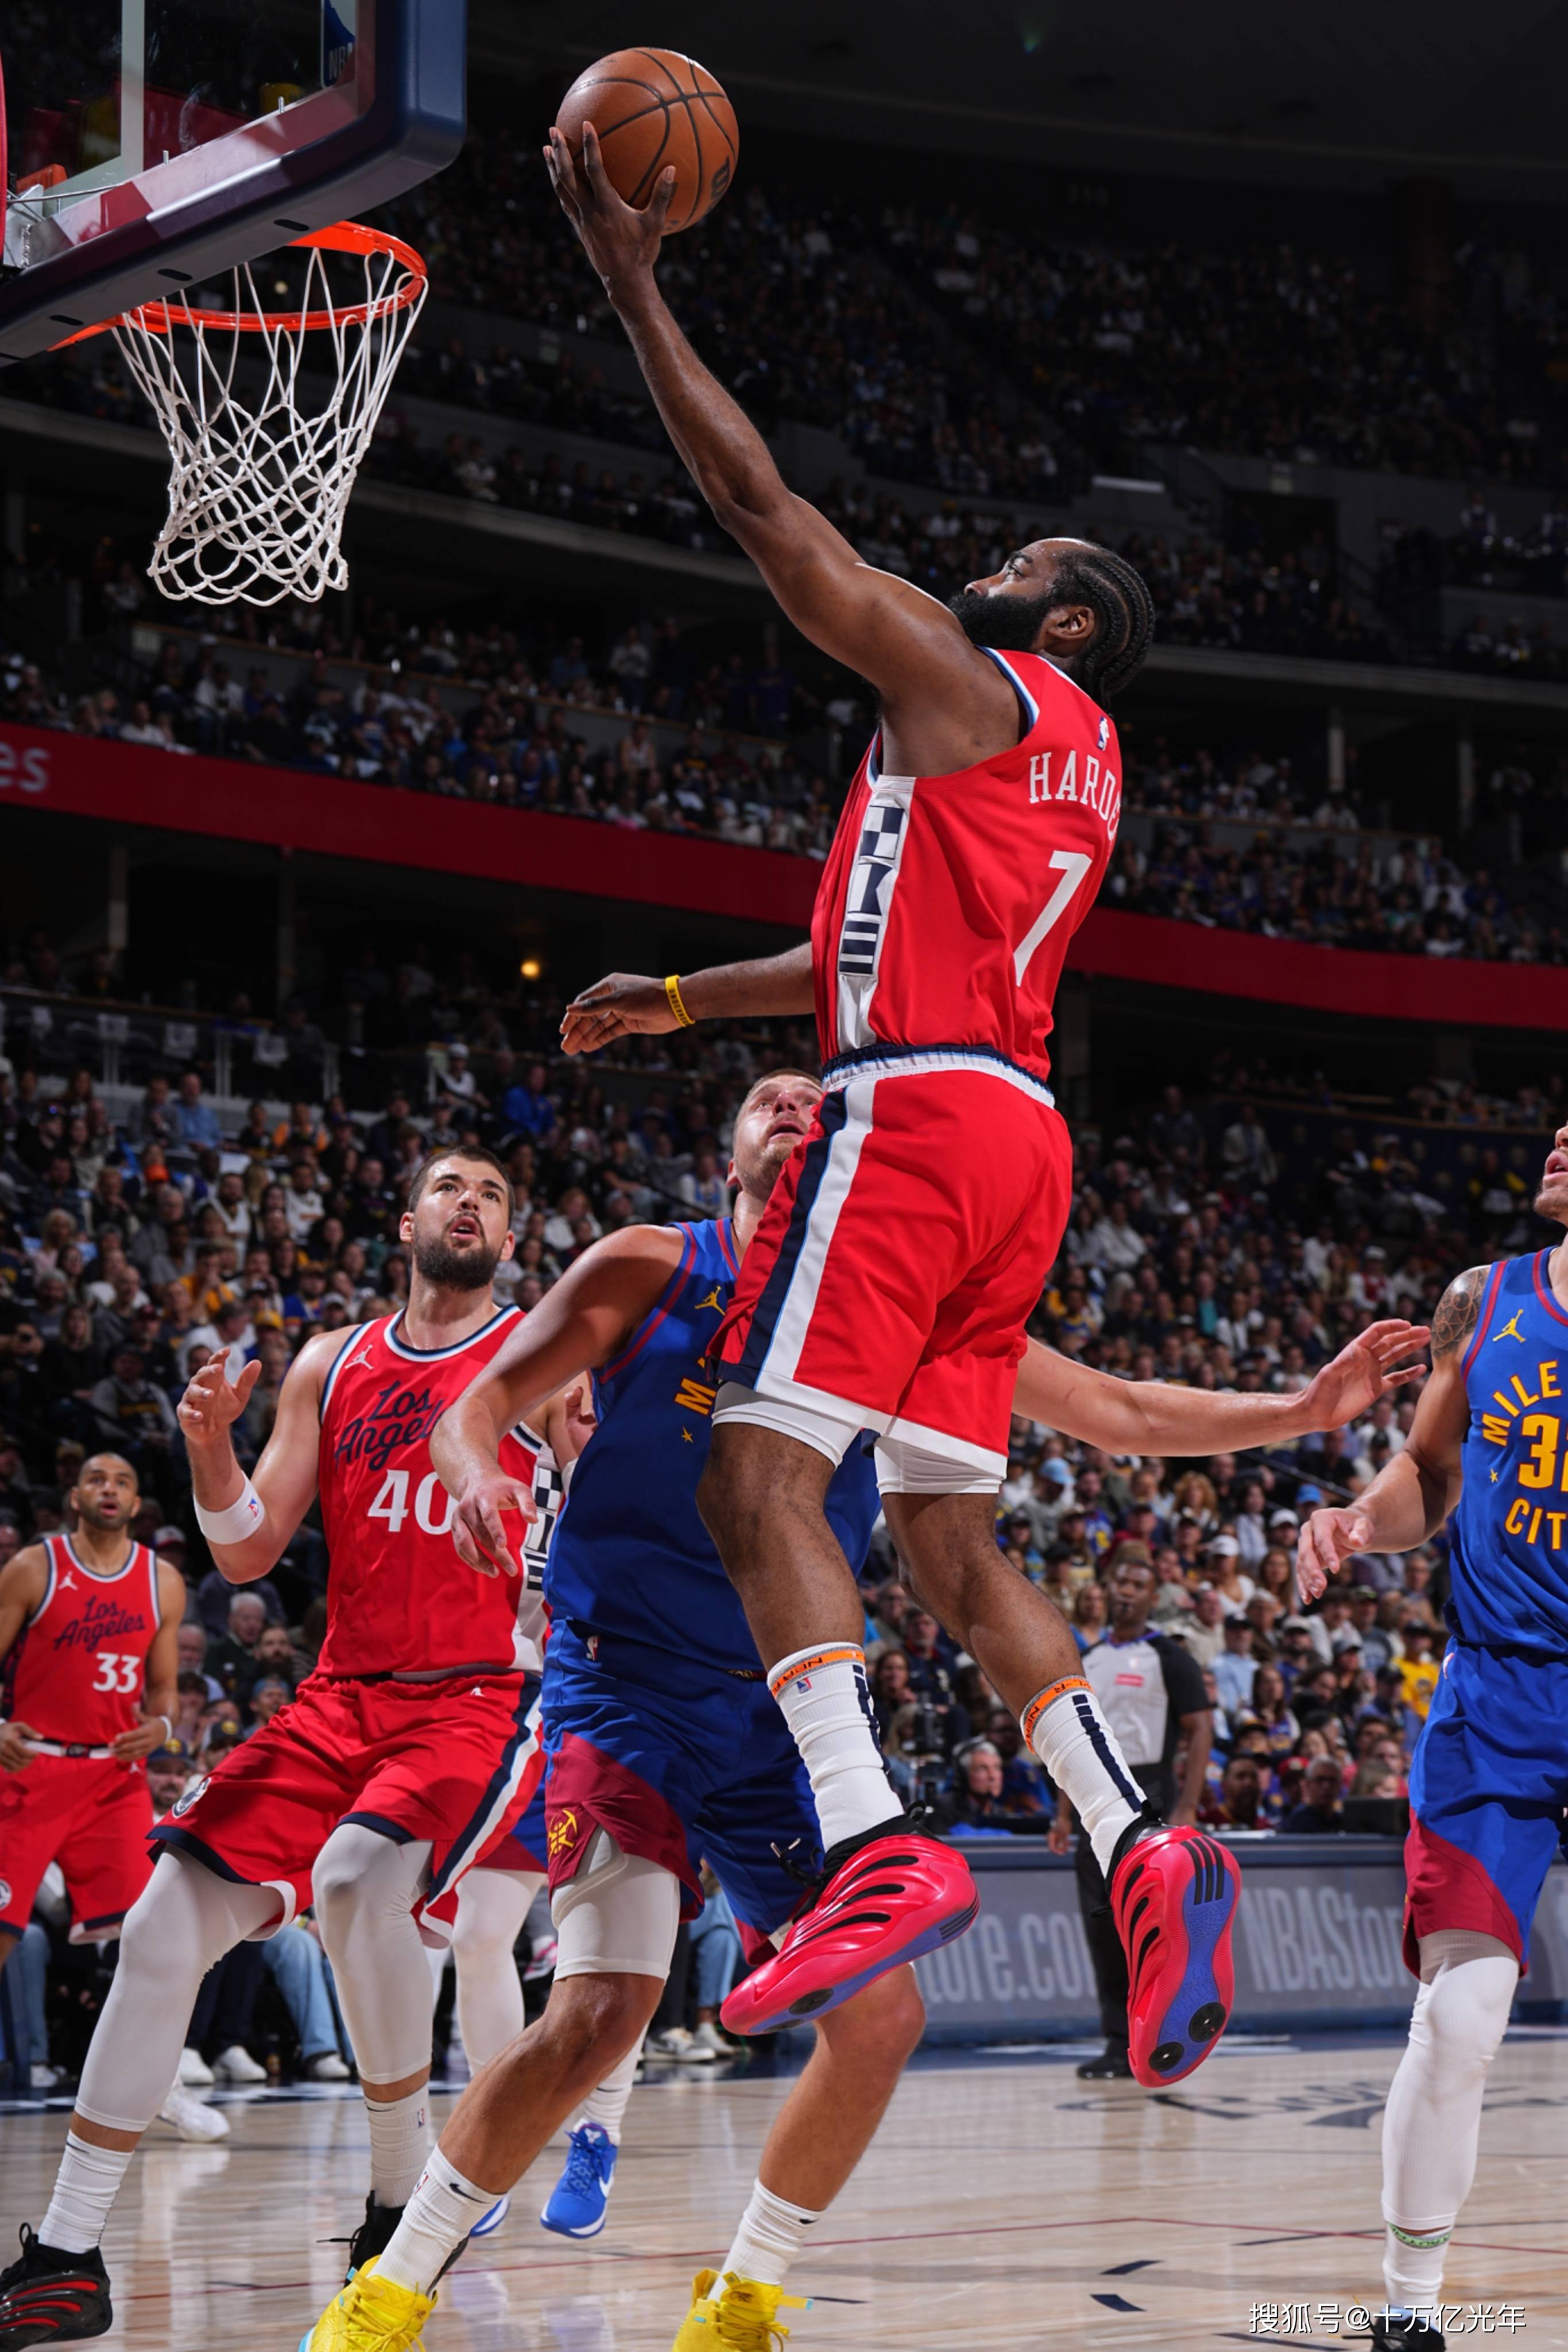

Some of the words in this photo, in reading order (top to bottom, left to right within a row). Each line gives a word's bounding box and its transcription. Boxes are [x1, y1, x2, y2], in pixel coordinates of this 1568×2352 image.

[1029, 750, 1121, 843] HARDE
[1013, 850, 1092, 987] 7
[334, 1399, 444, 1472] Angel
[368, 1380, 432, 1423] Los
[1482, 1360, 1562, 1447] MILE
[367, 1469, 460, 1535] 40
[54, 1610, 146, 1653] Angeles
[83, 1595, 119, 1622] Los
[92, 1651, 140, 1693] 33
[923, 1912, 1097, 2004] ore.co
